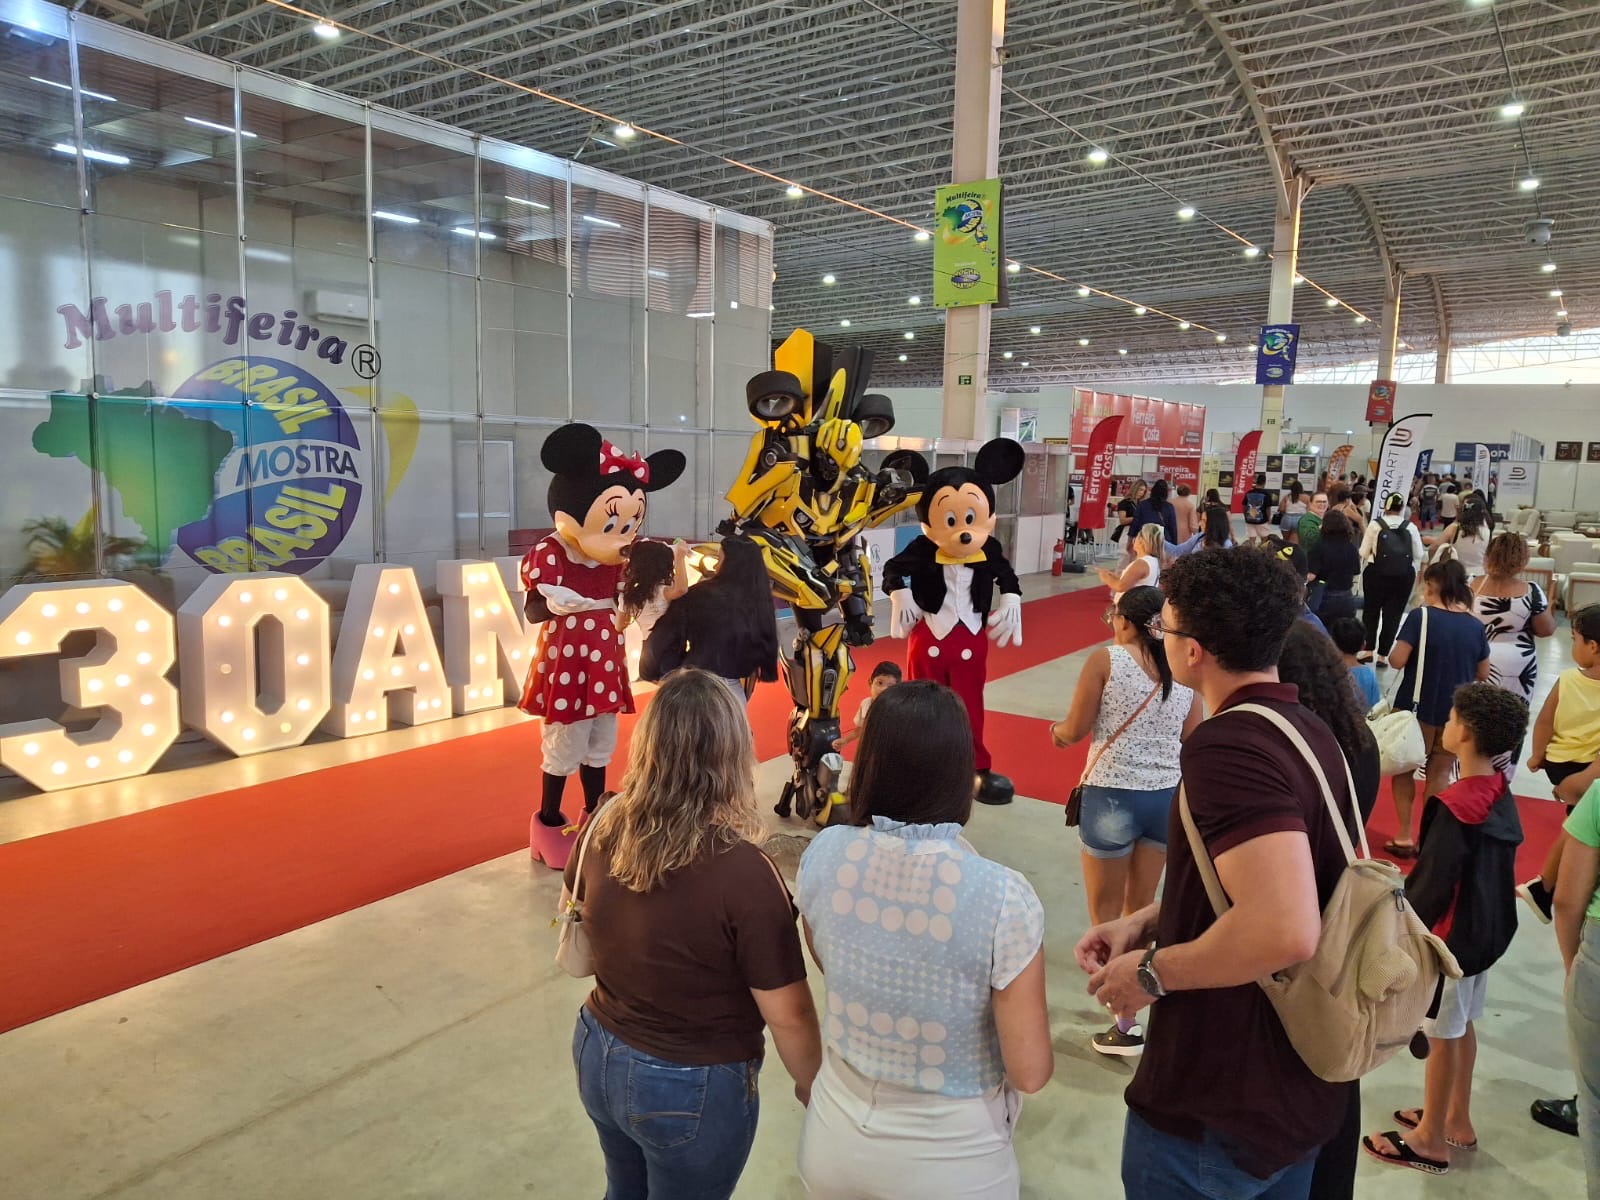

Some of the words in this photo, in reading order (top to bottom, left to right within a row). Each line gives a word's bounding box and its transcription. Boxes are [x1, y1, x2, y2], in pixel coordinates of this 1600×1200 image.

[57, 289, 349, 365] Multifeira
[196, 357, 333, 435] BRASIL
[1132, 409, 1156, 426] Ferreira
[1143, 427, 1160, 442] Costa
[236, 445, 360, 486] MOSTRA
[1087, 454, 1104, 503] Ferreira
[1102, 443, 1115, 479] Costa
[1159, 465, 1190, 474] Ferreira
[1174, 473, 1197, 481] Costa
[1237, 458, 1248, 494] Ferreira
[1246, 450, 1257, 477] Costa
[1376, 450, 1399, 519] ECORART
[195, 484, 347, 576] BRASIL
